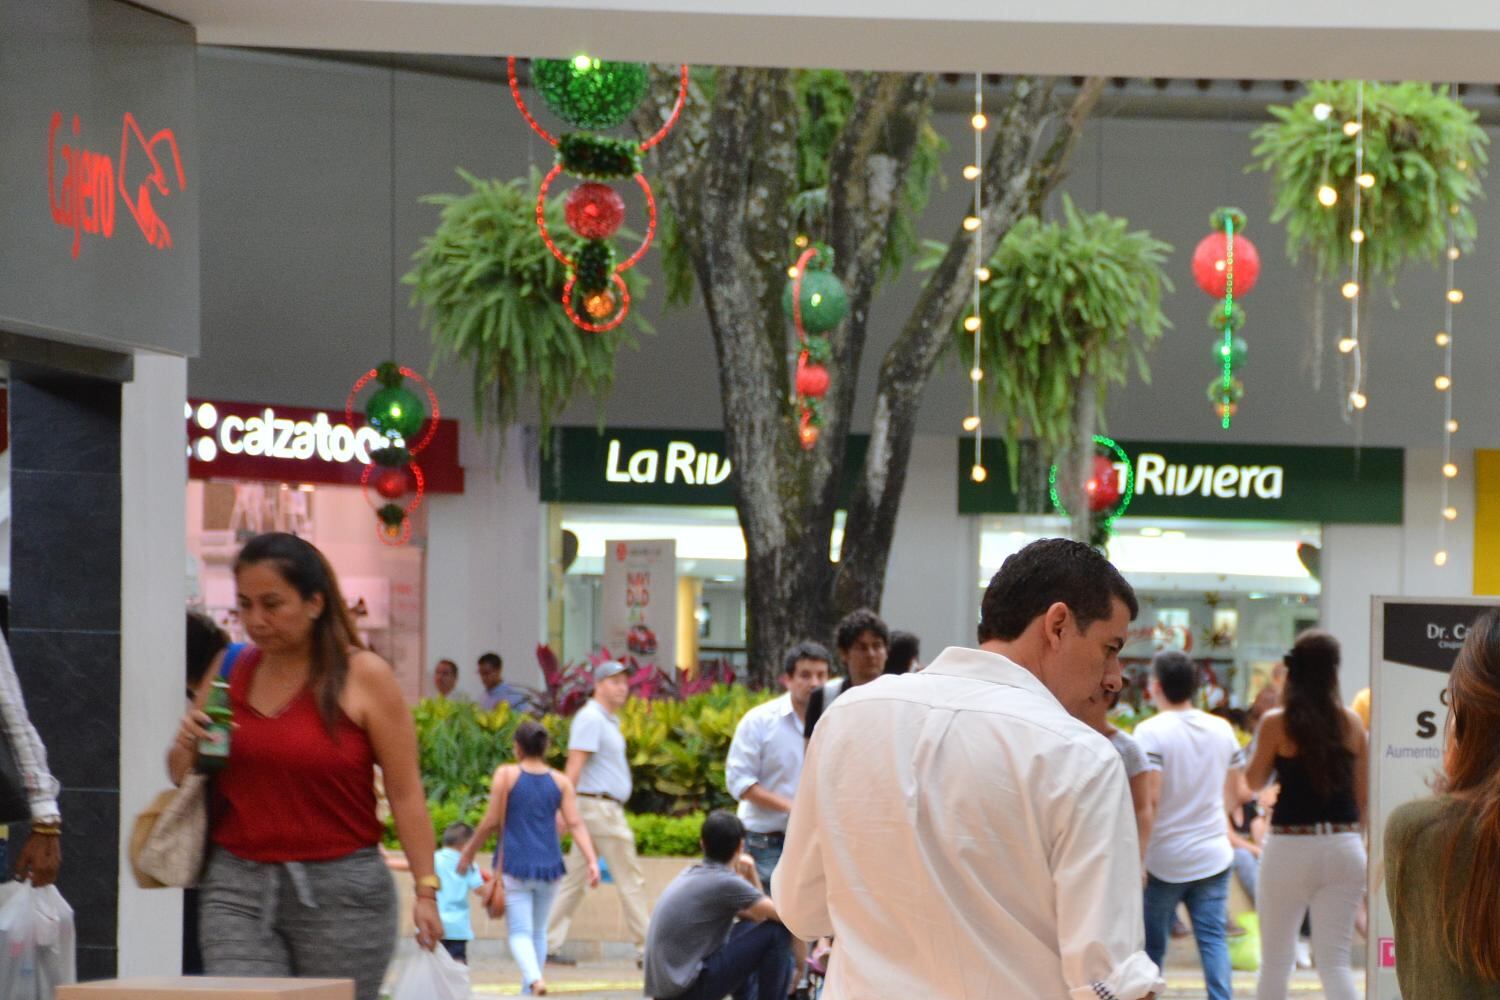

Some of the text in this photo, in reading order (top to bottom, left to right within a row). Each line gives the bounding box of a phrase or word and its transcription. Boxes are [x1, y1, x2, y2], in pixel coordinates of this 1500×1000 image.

[48, 111, 115, 261] Cajero
[220, 408, 405, 464] calzato
[605, 439, 658, 483] La
[1136, 453, 1283, 498] Riviera
[1427, 623, 1449, 639] Dr.
[1385, 744, 1440, 760] Aumento
